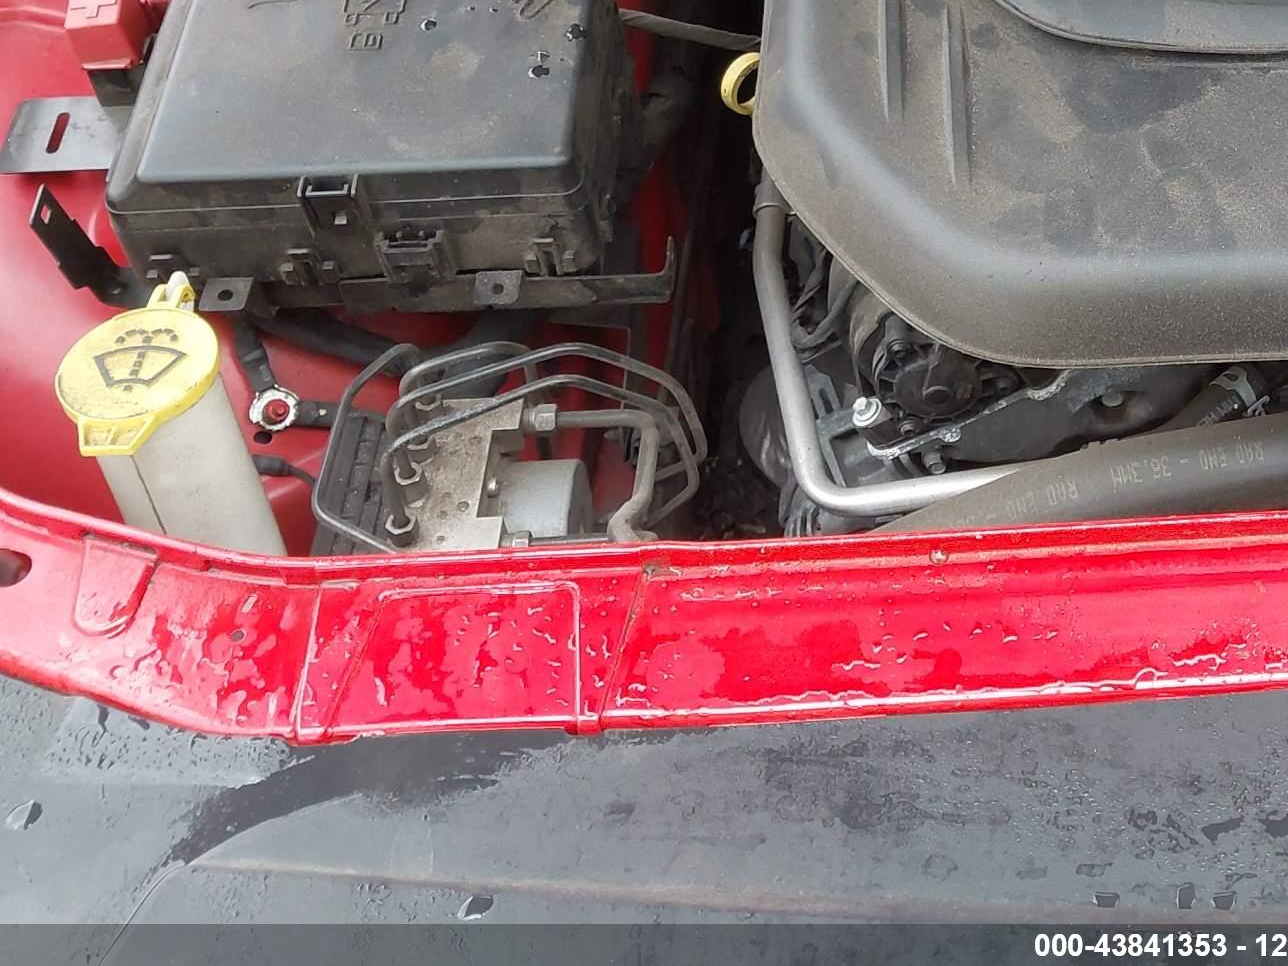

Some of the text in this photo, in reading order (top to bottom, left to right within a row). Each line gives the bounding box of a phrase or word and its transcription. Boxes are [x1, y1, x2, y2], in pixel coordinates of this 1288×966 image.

[1199, 446, 1228, 471] END
[1235, 441, 1265, 465] RAD
[1109, 455, 1173, 491] 36.3MM
[1046, 480, 1079, 506] RAD
